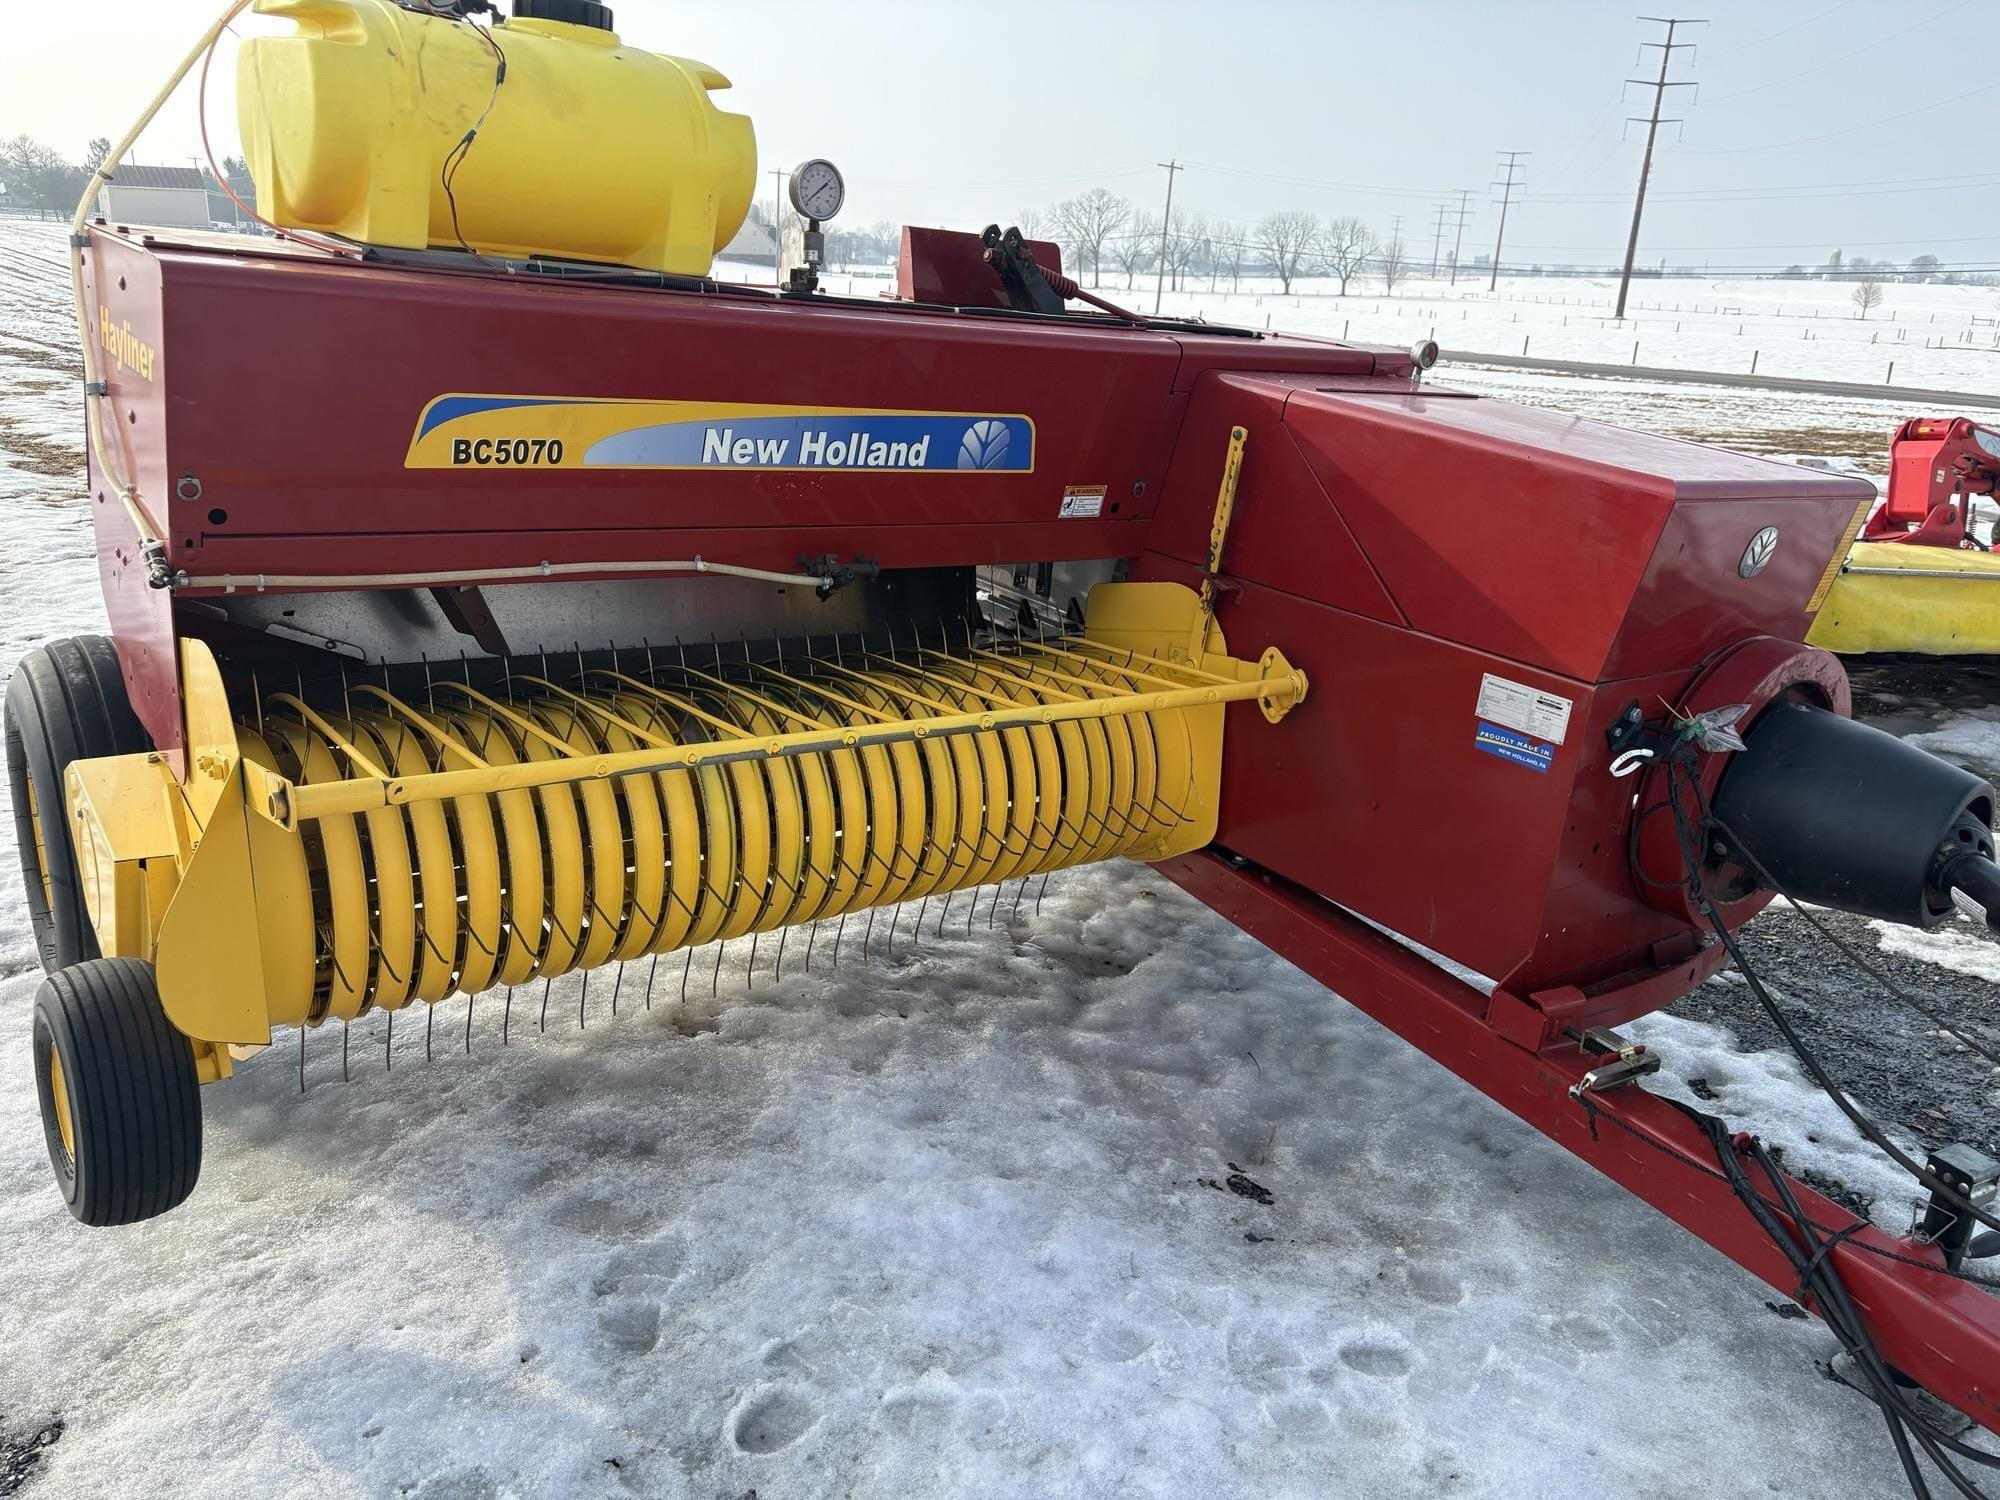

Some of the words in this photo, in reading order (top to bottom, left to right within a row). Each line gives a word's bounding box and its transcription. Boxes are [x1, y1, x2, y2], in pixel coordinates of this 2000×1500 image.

[100, 304, 155, 382] Hayliner
[452, 438, 564, 465] BC5070
[702, 427, 790, 464] New
[799, 431, 931, 467] Holland
[1479, 731, 1515, 745] PROUDLY
[1516, 741, 1538, 753] MADE
[1498, 748, 1511, 757] NEW
